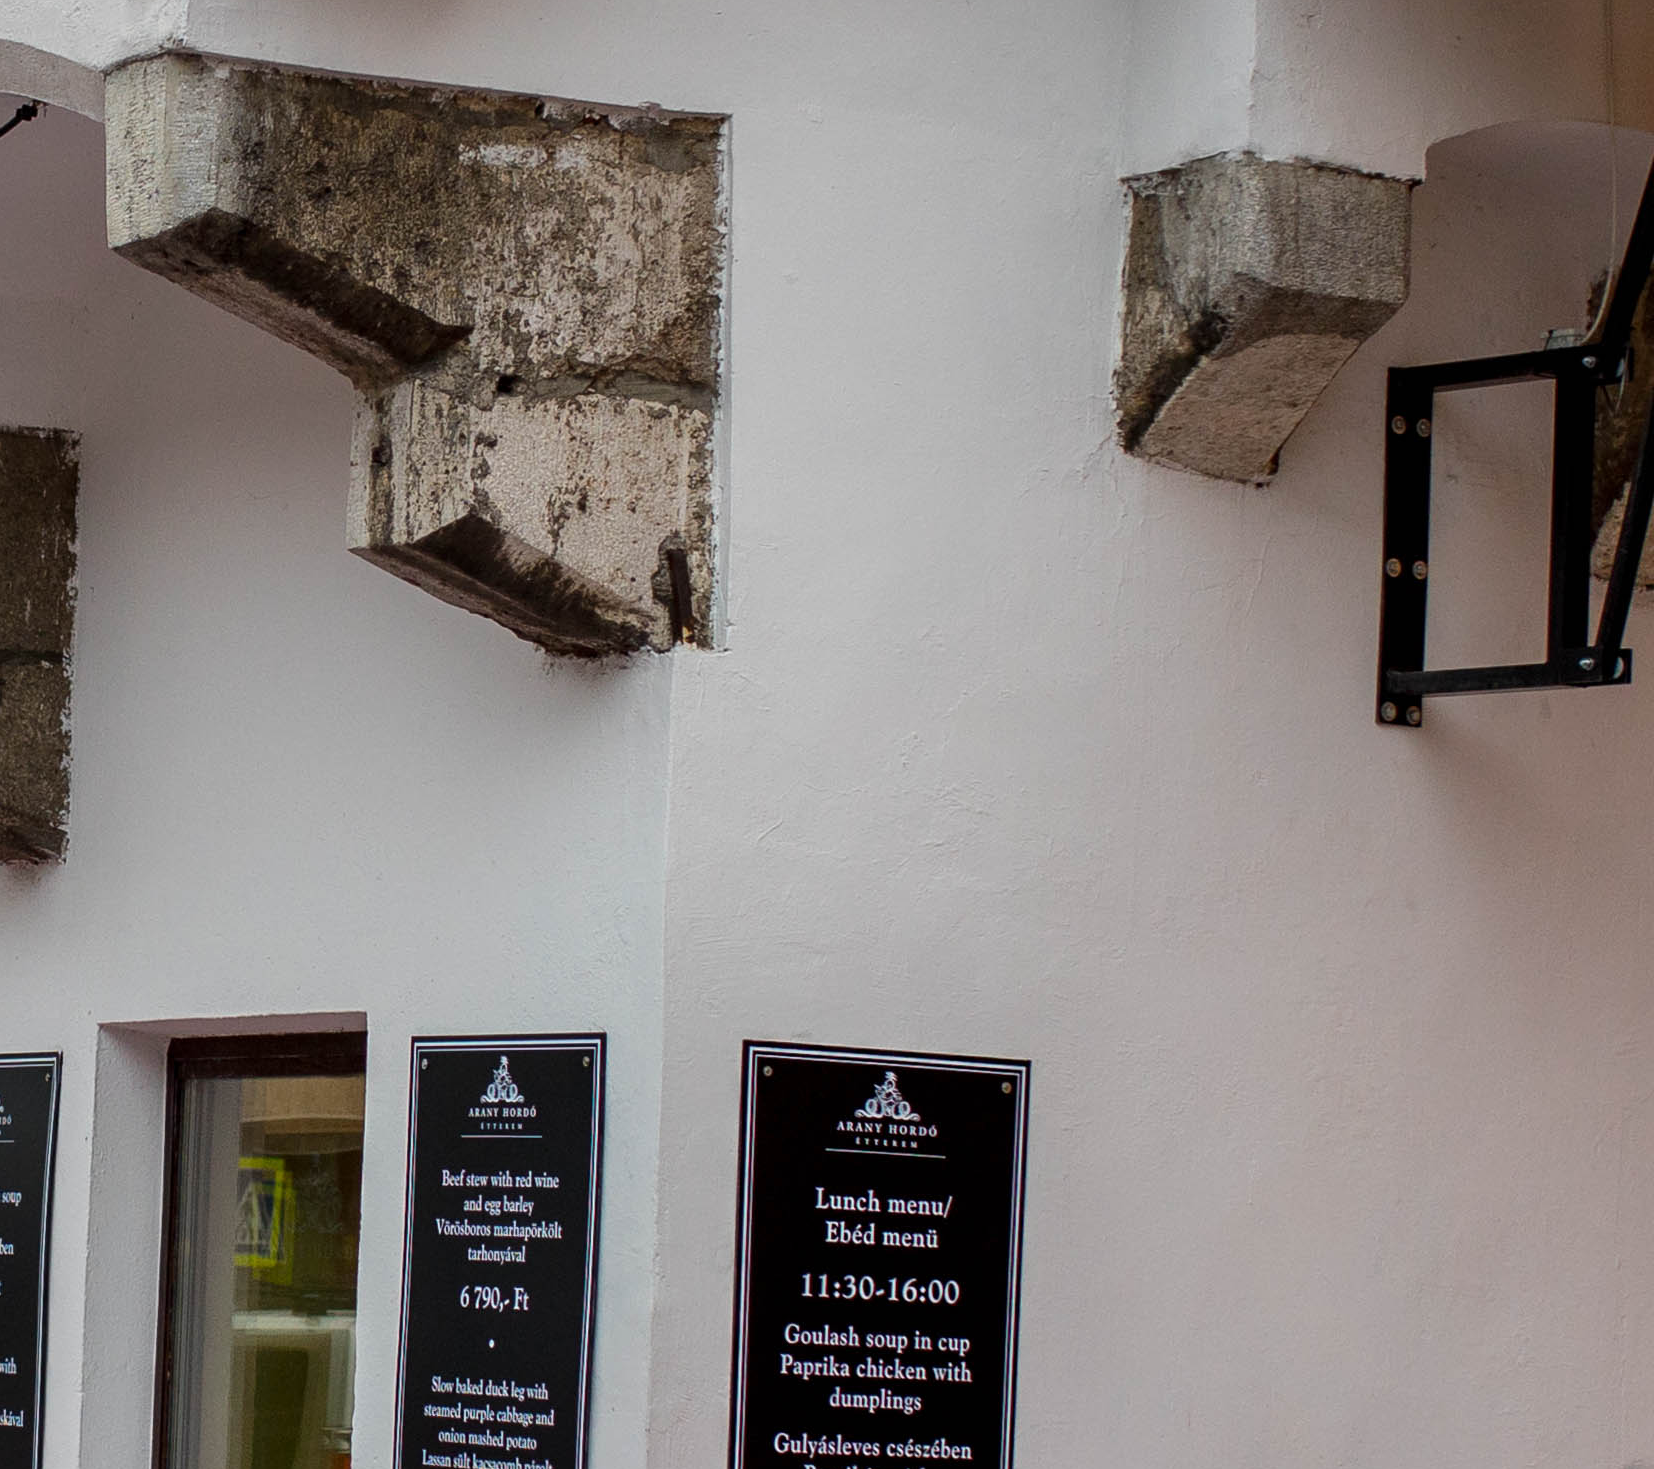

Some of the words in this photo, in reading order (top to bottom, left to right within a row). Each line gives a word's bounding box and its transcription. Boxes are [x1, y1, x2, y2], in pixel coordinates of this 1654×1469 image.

[468, 1108, 499, 1118] ARANY
[502, 1105, 537, 1118] HORDÓ
[837, 1120, 883, 1134] ARANY
[888, 1123, 938, 1137] HORDÓ
[442, 1169, 465, 1187] Beef
[466, 1172, 488, 1187] stew
[490, 1171, 513, 1187] with
[515, 1171, 533, 1188] red
[534, 1172, 560, 1188] wine
[2, 1190, 22, 1206] soup
[463, 1195, 482, 1211] and
[484, 1200, 501, 1216] egg
[503, 1195, 534, 1216] barley
[815, 1187, 880, 1212] Lunch
[887, 1195, 953, 1219] menu/
[436, 1218, 491, 1237] Vörösboros
[493, 1221, 562, 1241] marhapörkölt
[825, 1220, 876, 1245] Ebéd
[882, 1229, 939, 1249] menü
[467, 1244, 526, 1265] tarhonyával
[460, 1285, 469, 1308] 6
[474, 1286, 510, 1312] 790,-
[513, 1287, 529, 1311] Ft
[801, 1272, 960, 1305] 11:30-16:00
[784, 1323, 860, 1347] Goulash
[865, 1332, 908, 1354] soup
[913, 1331, 933, 1350] in
[937, 1337, 970, 1357] cup
[780, 1353, 850, 1380] Paprika
[856, 1357, 927, 1381] chicken
[932, 1362, 973, 1382] with
[431, 1376, 453, 1393] Slow
[455, 1378, 483, 1396] baked
[485, 1379, 509, 1397] duck
[510, 1380, 525, 1401] leg
[526, 1383, 549, 1400] with
[829, 1386, 922, 1414] dumplings
[423, 1403, 461, 1419] steamed
[463, 1406, 495, 1428] purple
[496, 1406, 534, 1427] cabbage
[535, 1410, 554, 1426] and
[438, 1429, 466, 1445] onion
[468, 1430, 504, 1448] mashed
[506, 1435, 537, 1450] potato
[773, 1432, 880, 1459] Gulyásleves
[886, 1438, 973, 1460] csészében
[422, 1449, 451, 1468] Lassan
[453, 1453, 470, 1469] sült
